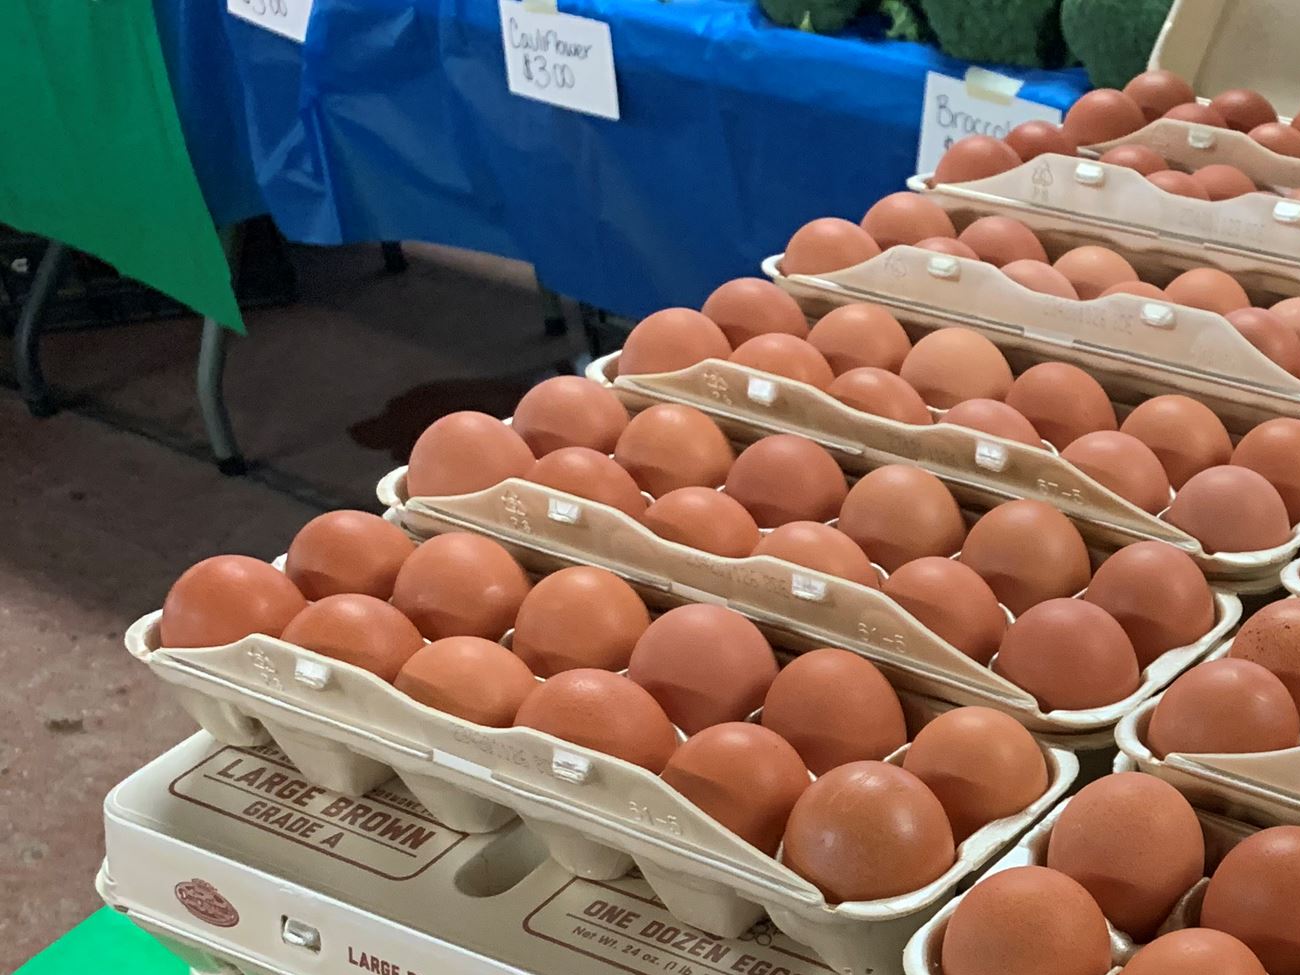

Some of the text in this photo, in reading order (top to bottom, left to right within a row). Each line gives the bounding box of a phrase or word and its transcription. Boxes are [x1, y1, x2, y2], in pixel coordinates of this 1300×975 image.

[217, 758, 326, 807] LARGE
[320, 796, 437, 851] BROWN
[242, 800, 345, 849] GRADE A
[572, 925, 599, 942] Net
[600, 934, 619, 951] Wt.
[621, 944, 643, 957] 24
[642, 953, 660, 967] oz.
[582, 900, 641, 930] ONE
[639, 919, 731, 964] DOZEN
